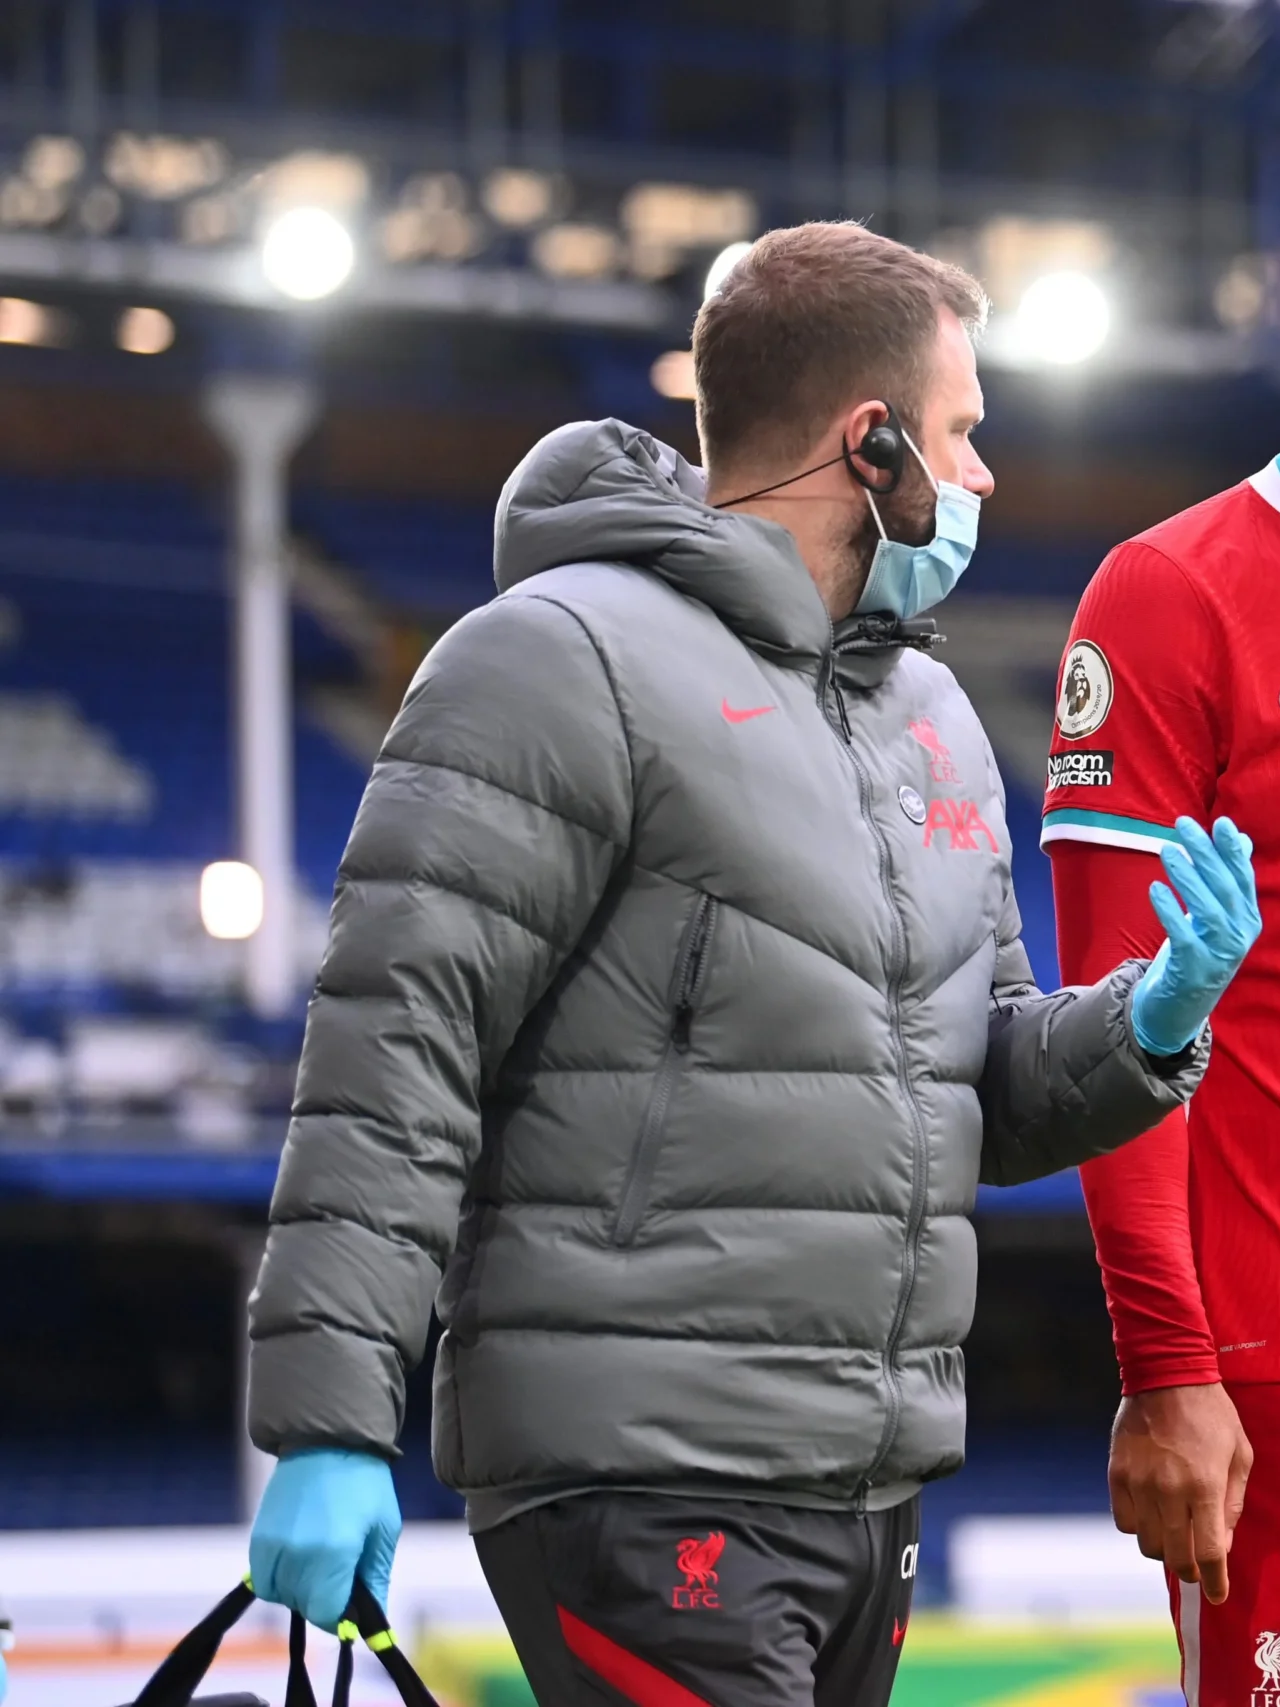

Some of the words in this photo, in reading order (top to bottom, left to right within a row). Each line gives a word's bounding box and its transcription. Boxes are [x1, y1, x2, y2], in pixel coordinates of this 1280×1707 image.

[1048, 755, 1062, 775] No
[1062, 754, 1104, 770] room
[1057, 770, 1112, 788] racism
[923, 798, 999, 854] AXA
